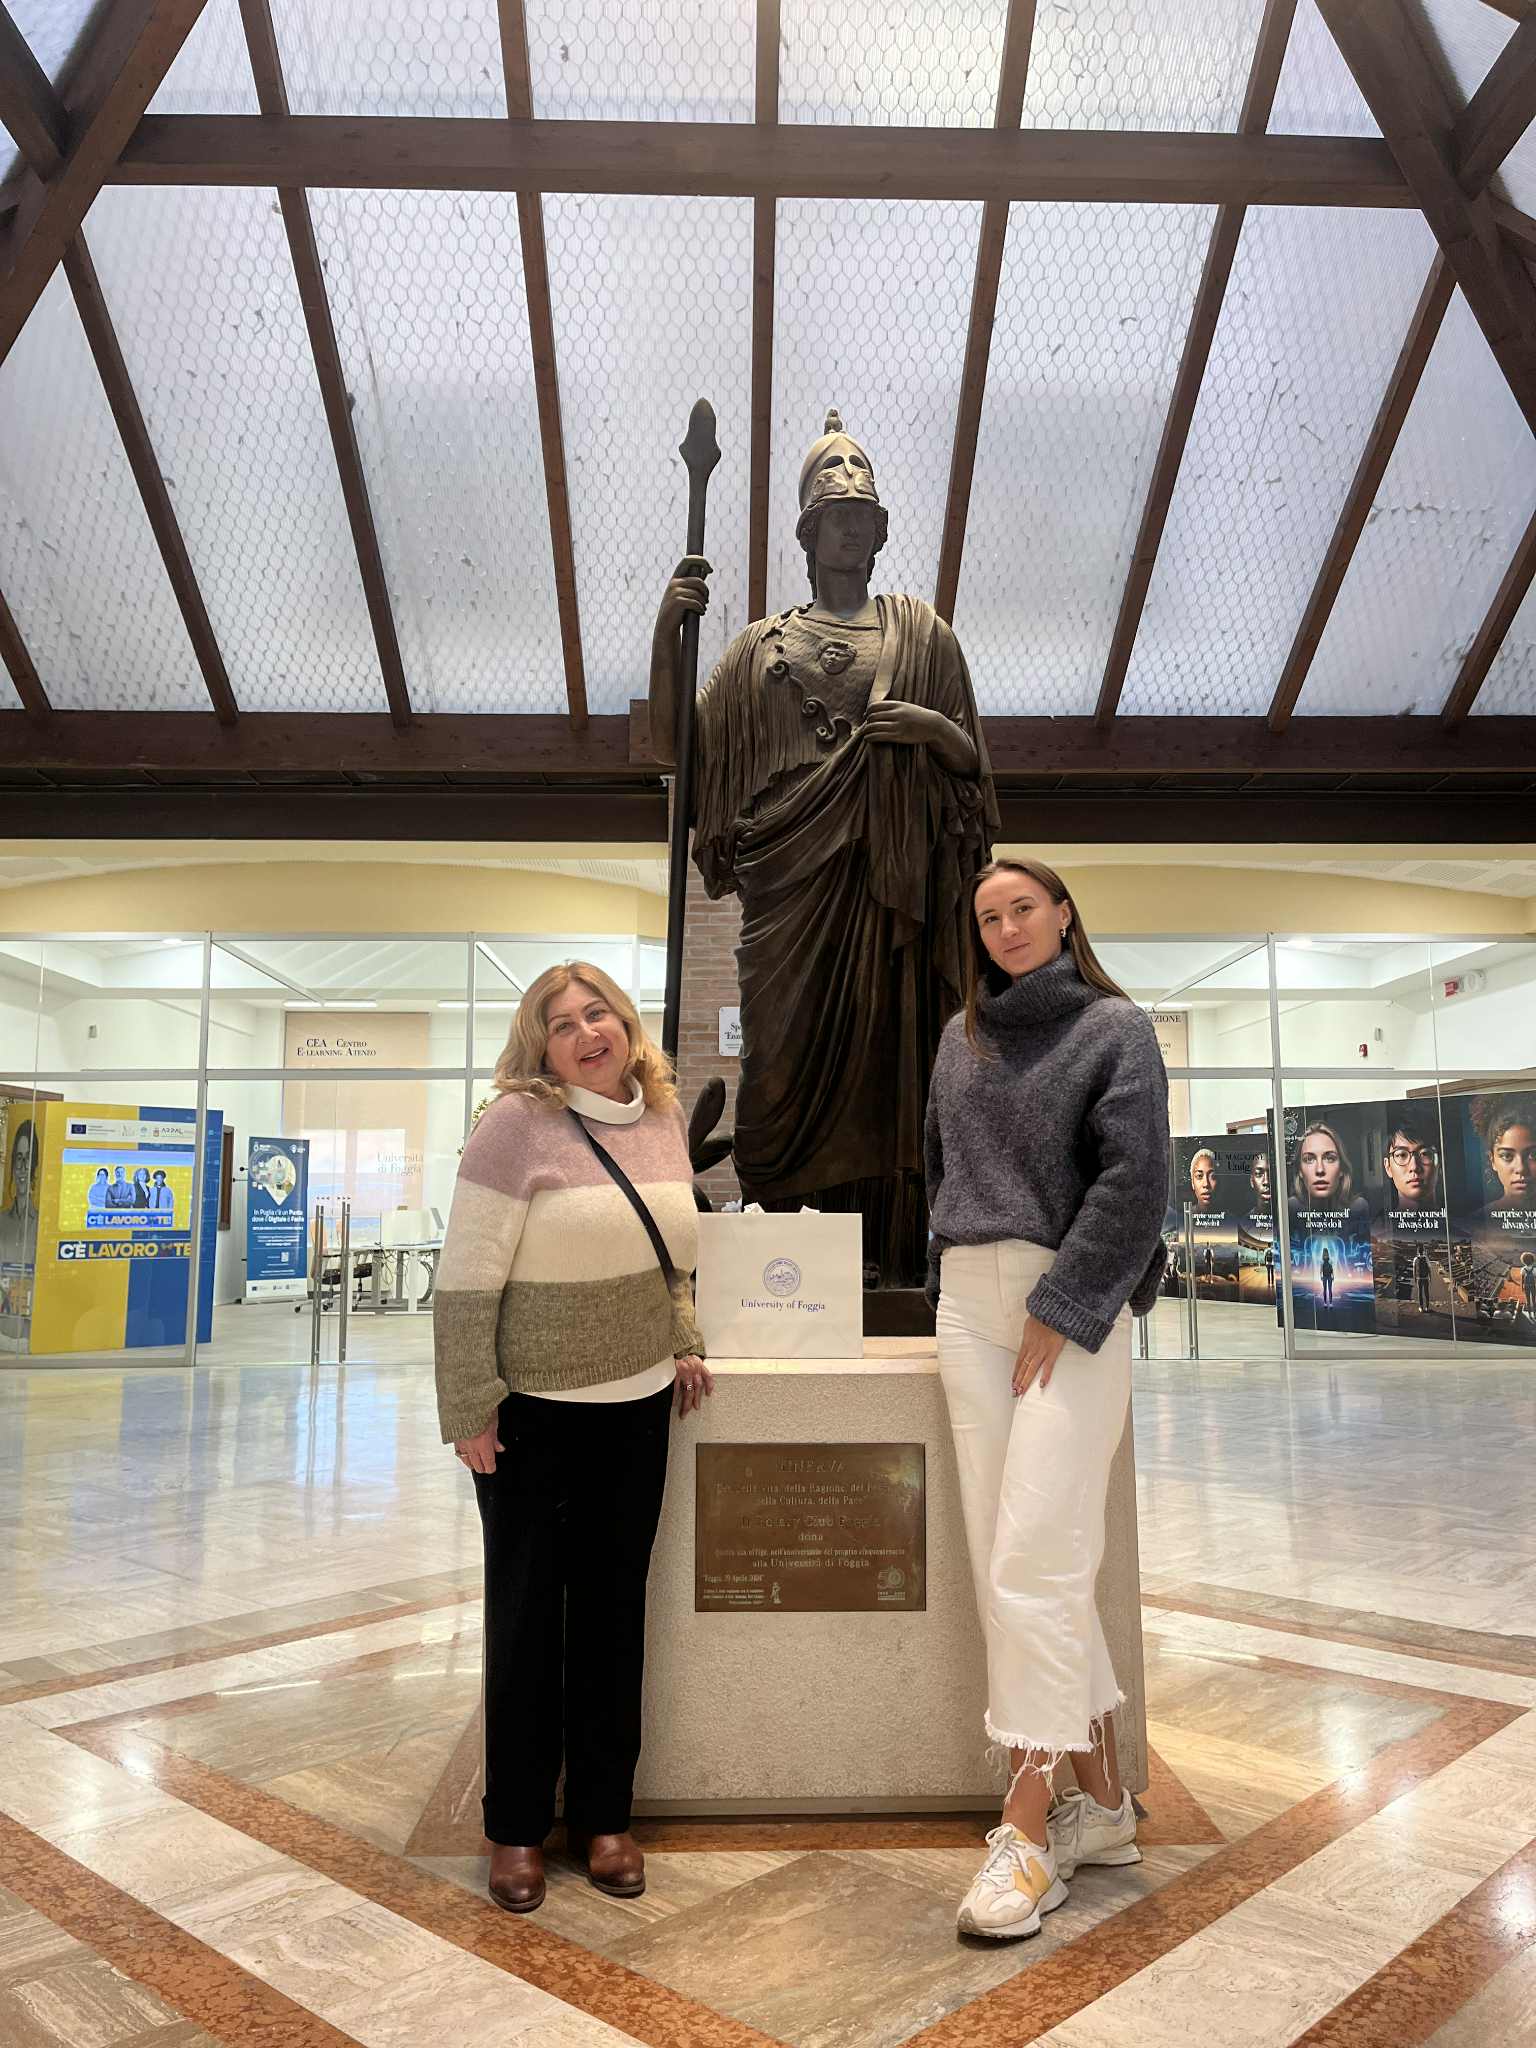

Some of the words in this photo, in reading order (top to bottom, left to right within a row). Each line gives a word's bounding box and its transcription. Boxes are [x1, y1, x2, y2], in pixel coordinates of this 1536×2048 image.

[1151, 1014, 1181, 1023] AZIONE
[306, 1038, 327, 1048] CEA
[105, 1215, 147, 1225] LAVORO
[1191, 1213, 1207, 1223] urprise
[1297, 1209, 1323, 1222] surprise
[1324, 1208, 1351, 1221] yourself
[1388, 1209, 1417, 1222] surprise
[1418, 1207, 1447, 1221] yourself
[1490, 1208, 1523, 1222] surprise
[1305, 1218, 1327, 1231] always
[1327, 1219, 1337, 1228] do
[1398, 1218, 1422, 1232] always
[1422, 1219, 1433, 1229] do
[1433, 1219, 1439, 1229] it
[1502, 1218, 1530, 1233] always
[60, 1240, 87, 1258] C'È
[88, 1242, 159, 1258] LAVORO
[741, 1299, 784, 1311] University
[786, 1300, 795, 1309] of
[797, 1300, 826, 1313] Foggia
